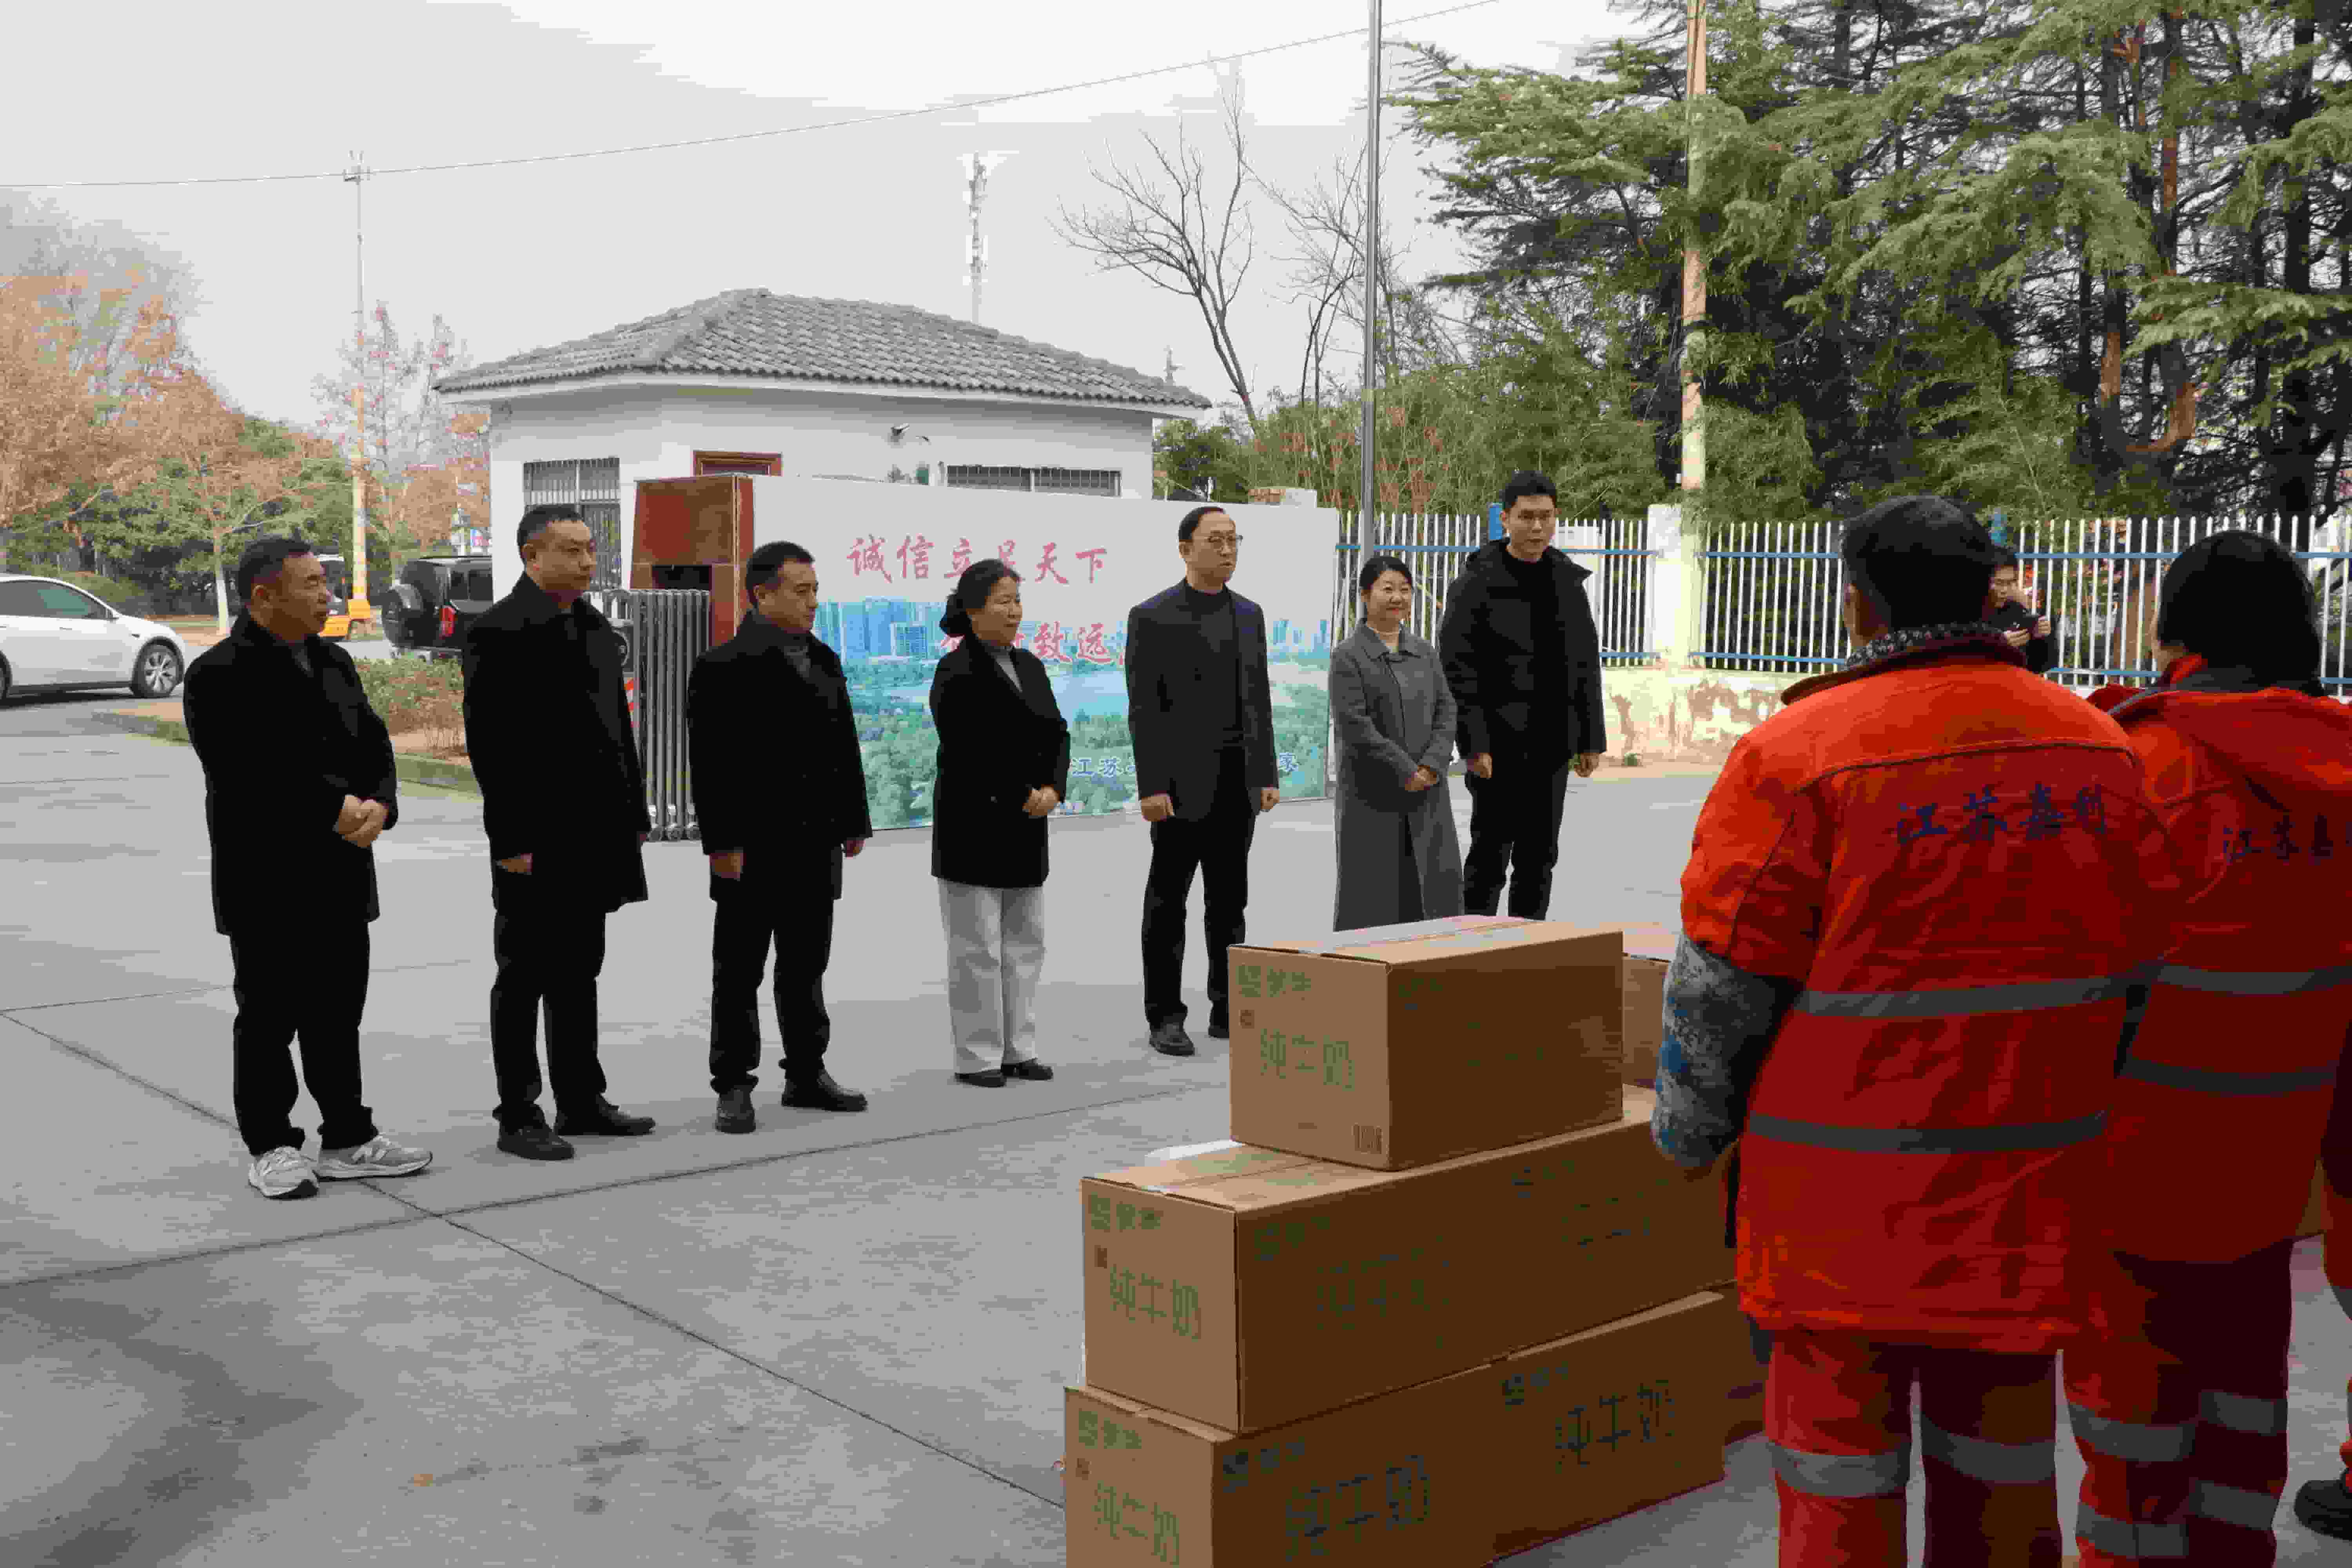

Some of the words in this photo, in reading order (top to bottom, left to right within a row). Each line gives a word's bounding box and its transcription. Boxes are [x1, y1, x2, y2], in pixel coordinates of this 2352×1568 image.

[846, 534, 1107, 584] 诚信立足天下
[2223, 811, 2352, 866] 江苏嘉
[1259, 1028, 1356, 1093] 纯牛奶
[1109, 1263, 1201, 1342] 纯牛奶
[1285, 1454, 1431, 1562] 纯牛奶
